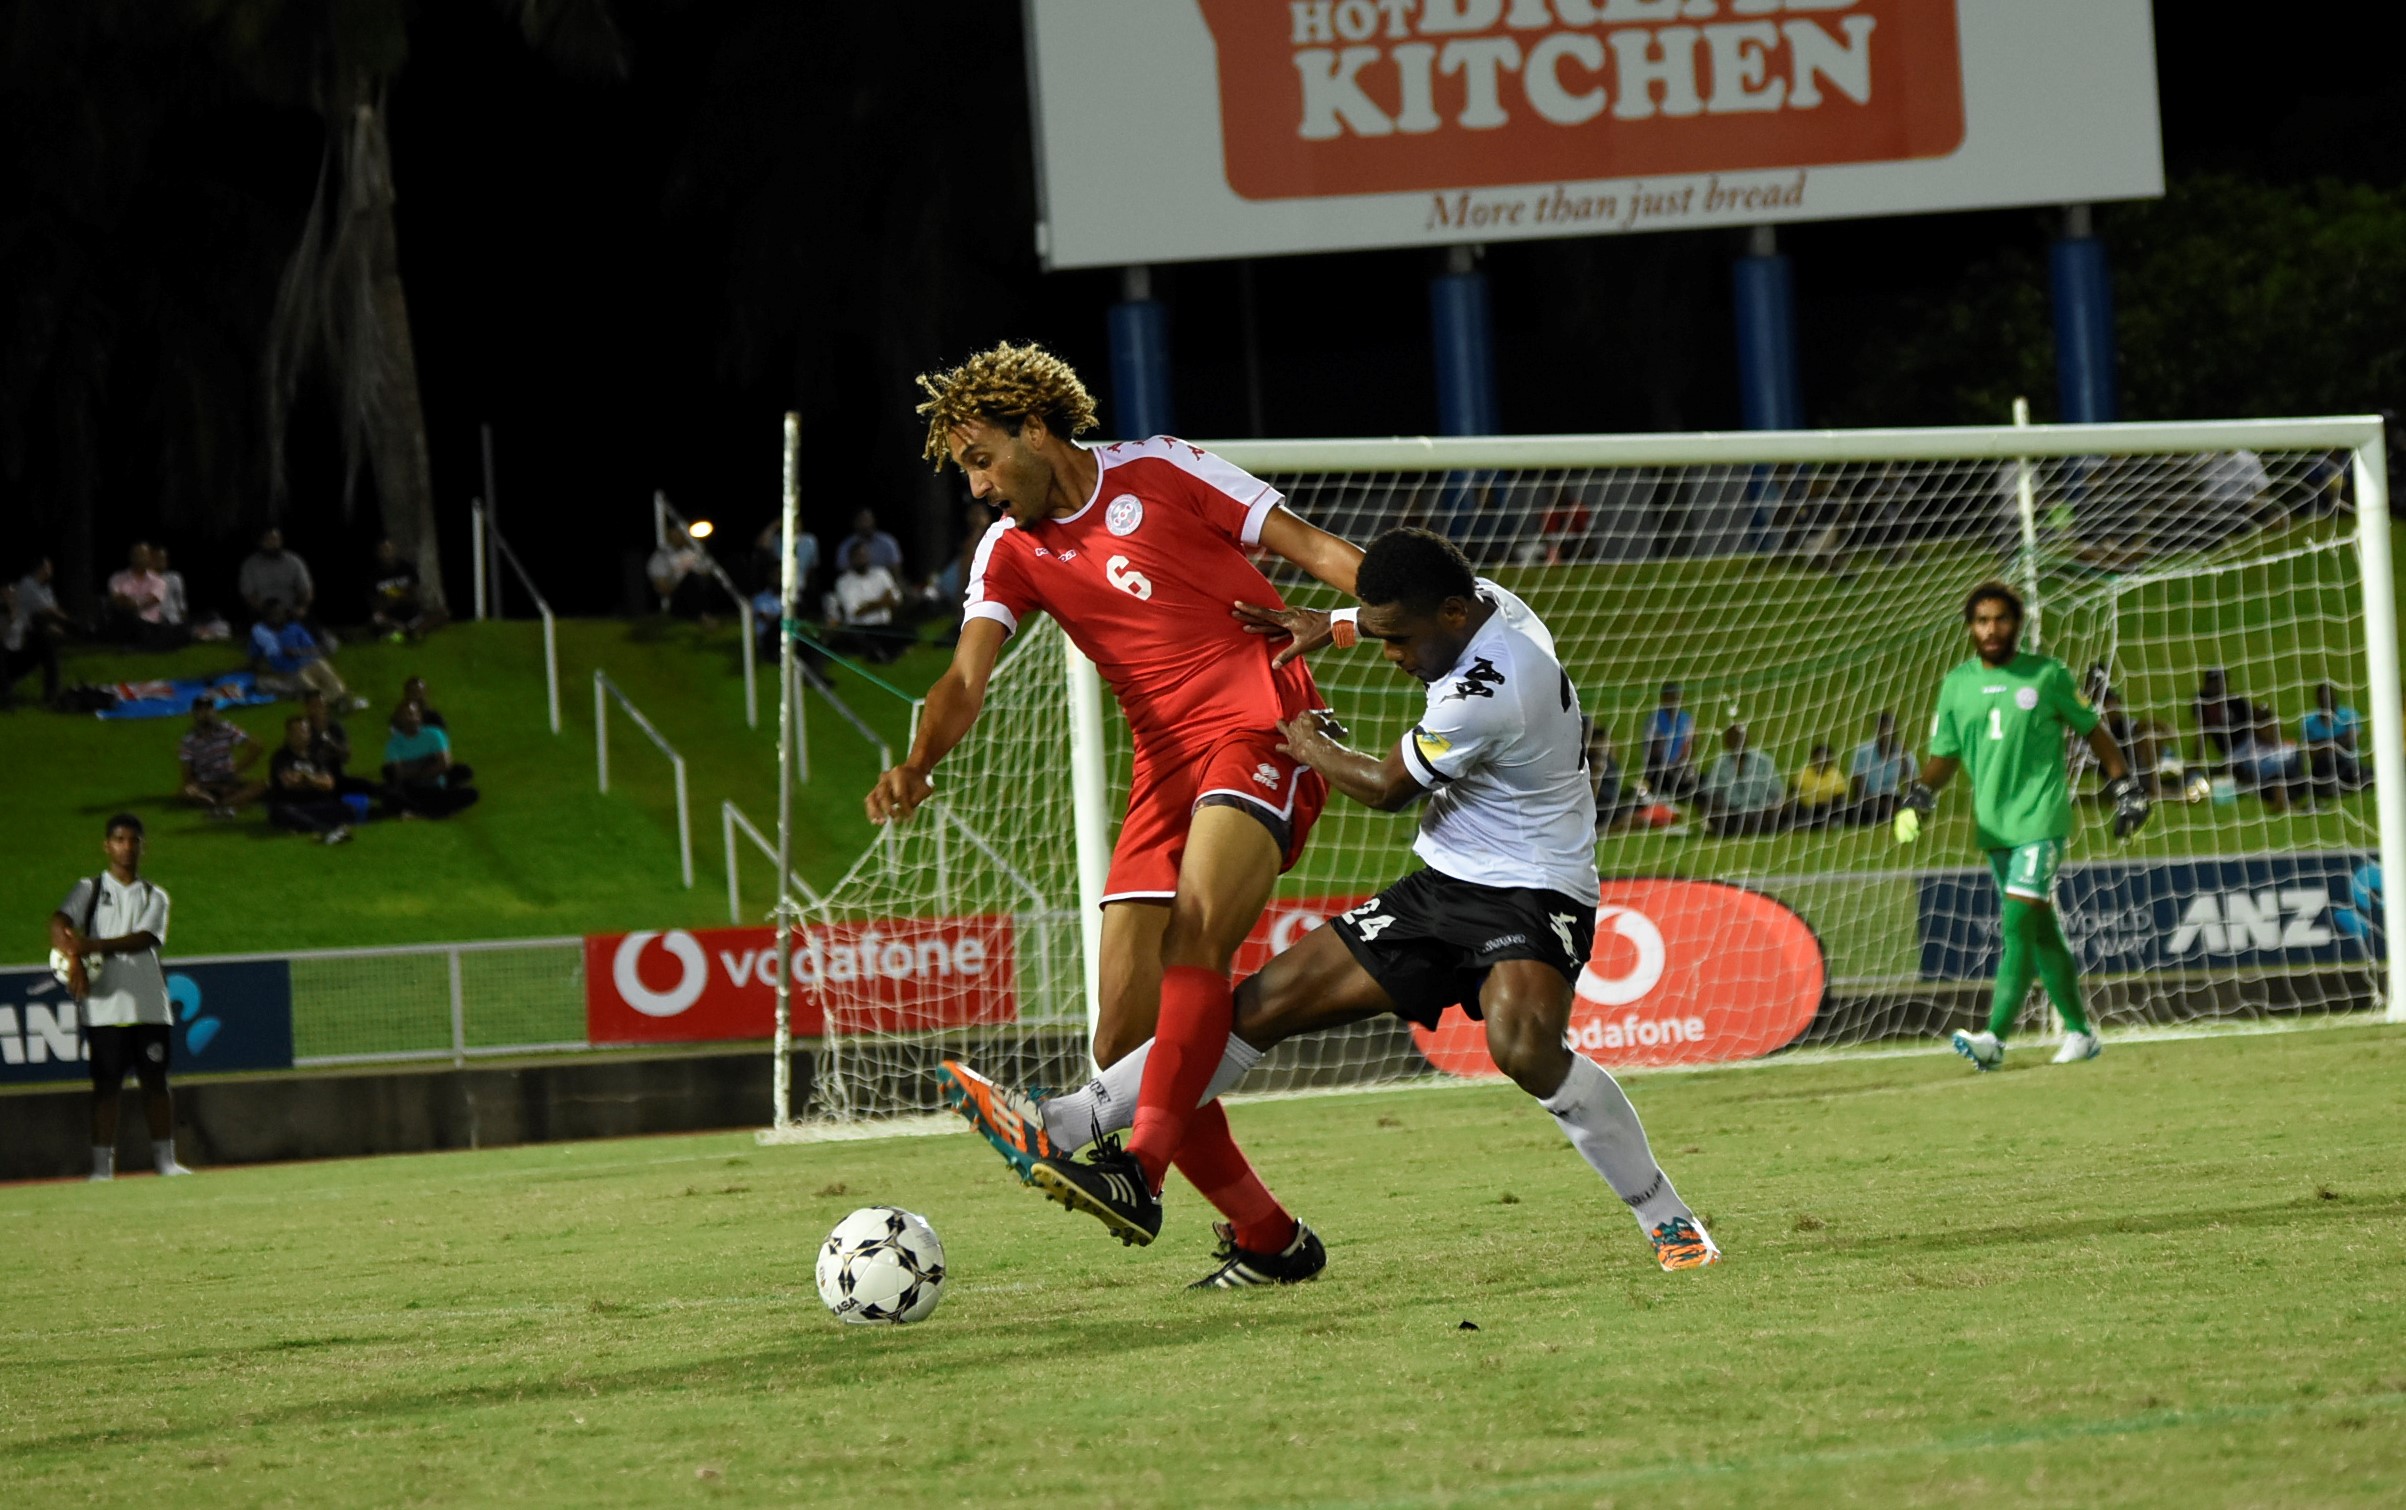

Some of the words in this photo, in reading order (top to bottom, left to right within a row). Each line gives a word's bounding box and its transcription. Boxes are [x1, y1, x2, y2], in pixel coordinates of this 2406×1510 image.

[1292, 0, 1416, 44] HOT
[1292, 14, 1877, 140] KITCHEN
[1426, 190, 1525, 230] More
[1532, 182, 1618, 224] than
[1619, 182, 1695, 231] just
[1703, 169, 1808, 213] bread
[1106, 555, 1152, 601] 6
[1989, 708, 2003, 740] 1
[2023, 846, 2040, 877] 1
[1341, 897, 1397, 942] 24
[2166, 889, 2332, 953] ANZ
[719, 931, 986, 988] vodafone
[1566, 1014, 1706, 1051] odafone
